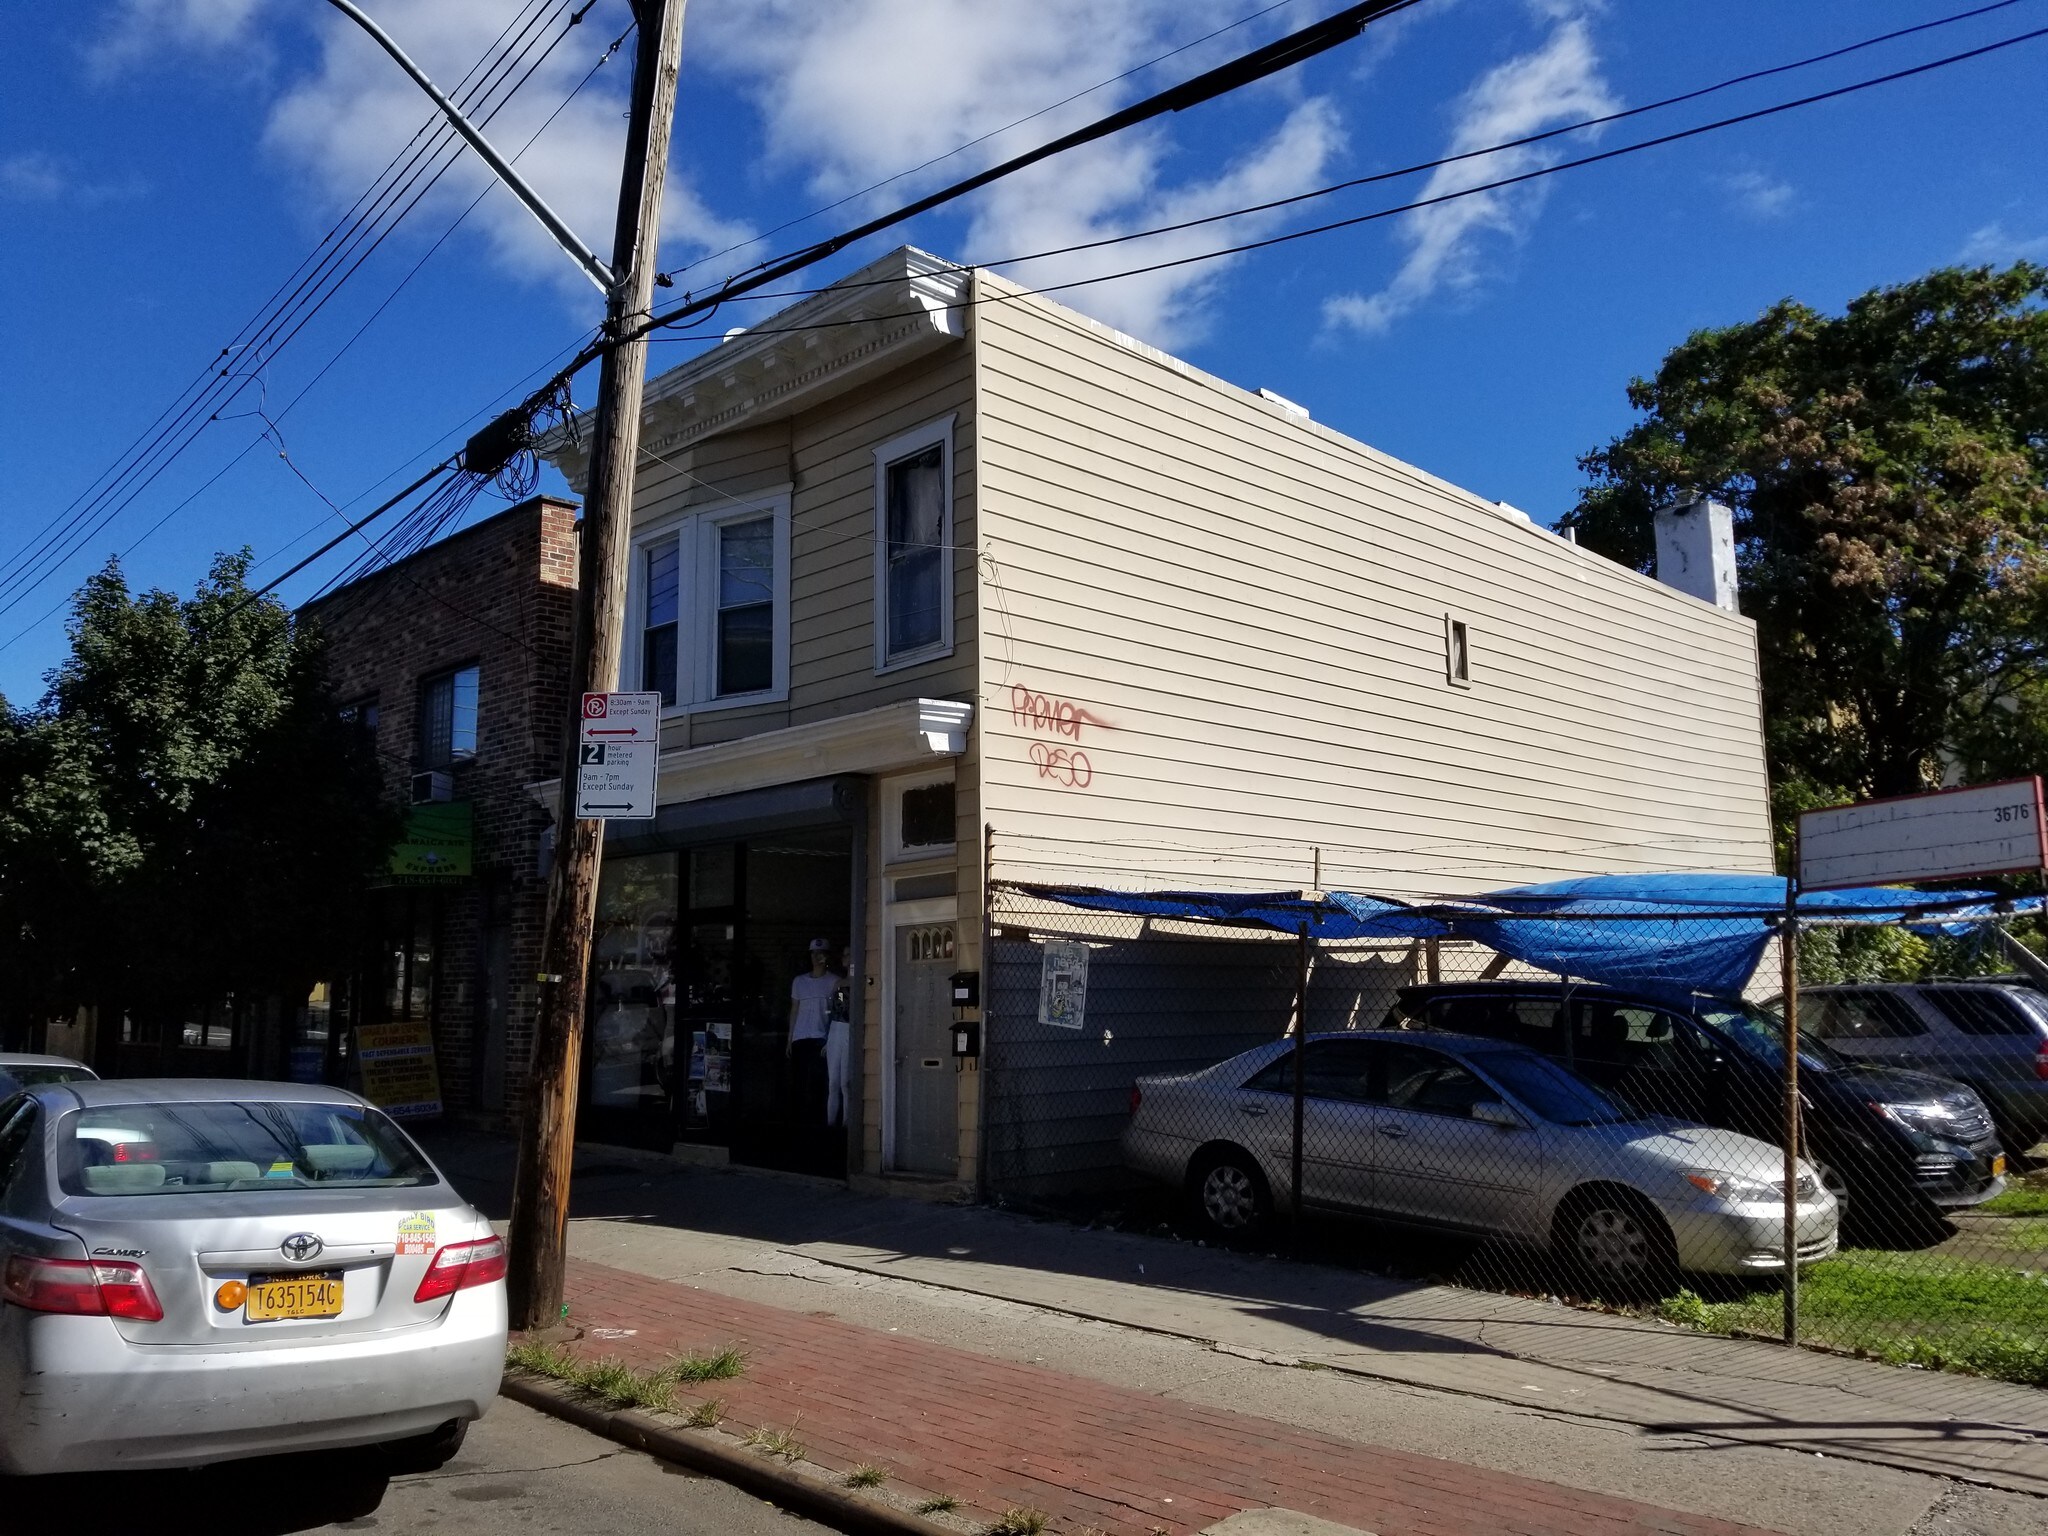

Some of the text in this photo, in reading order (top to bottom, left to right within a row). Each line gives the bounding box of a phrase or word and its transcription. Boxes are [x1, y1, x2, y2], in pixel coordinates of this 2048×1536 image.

[610, 698, 632, 706] 8:30am
[609, 708, 652, 716] Except Sunday
[586, 744, 599, 763] 2
[607, 751, 632, 759] metered
[606, 759, 630, 767] parking
[583, 773, 598, 781] 9am
[605, 773, 620, 782] 7pm
[582, 782, 634, 792] Except Sunday
[1994, 804, 2030, 823] 3676
[420, 1212, 435, 1228] BIRD
[256, 1283, 336, 1310] T635154C
